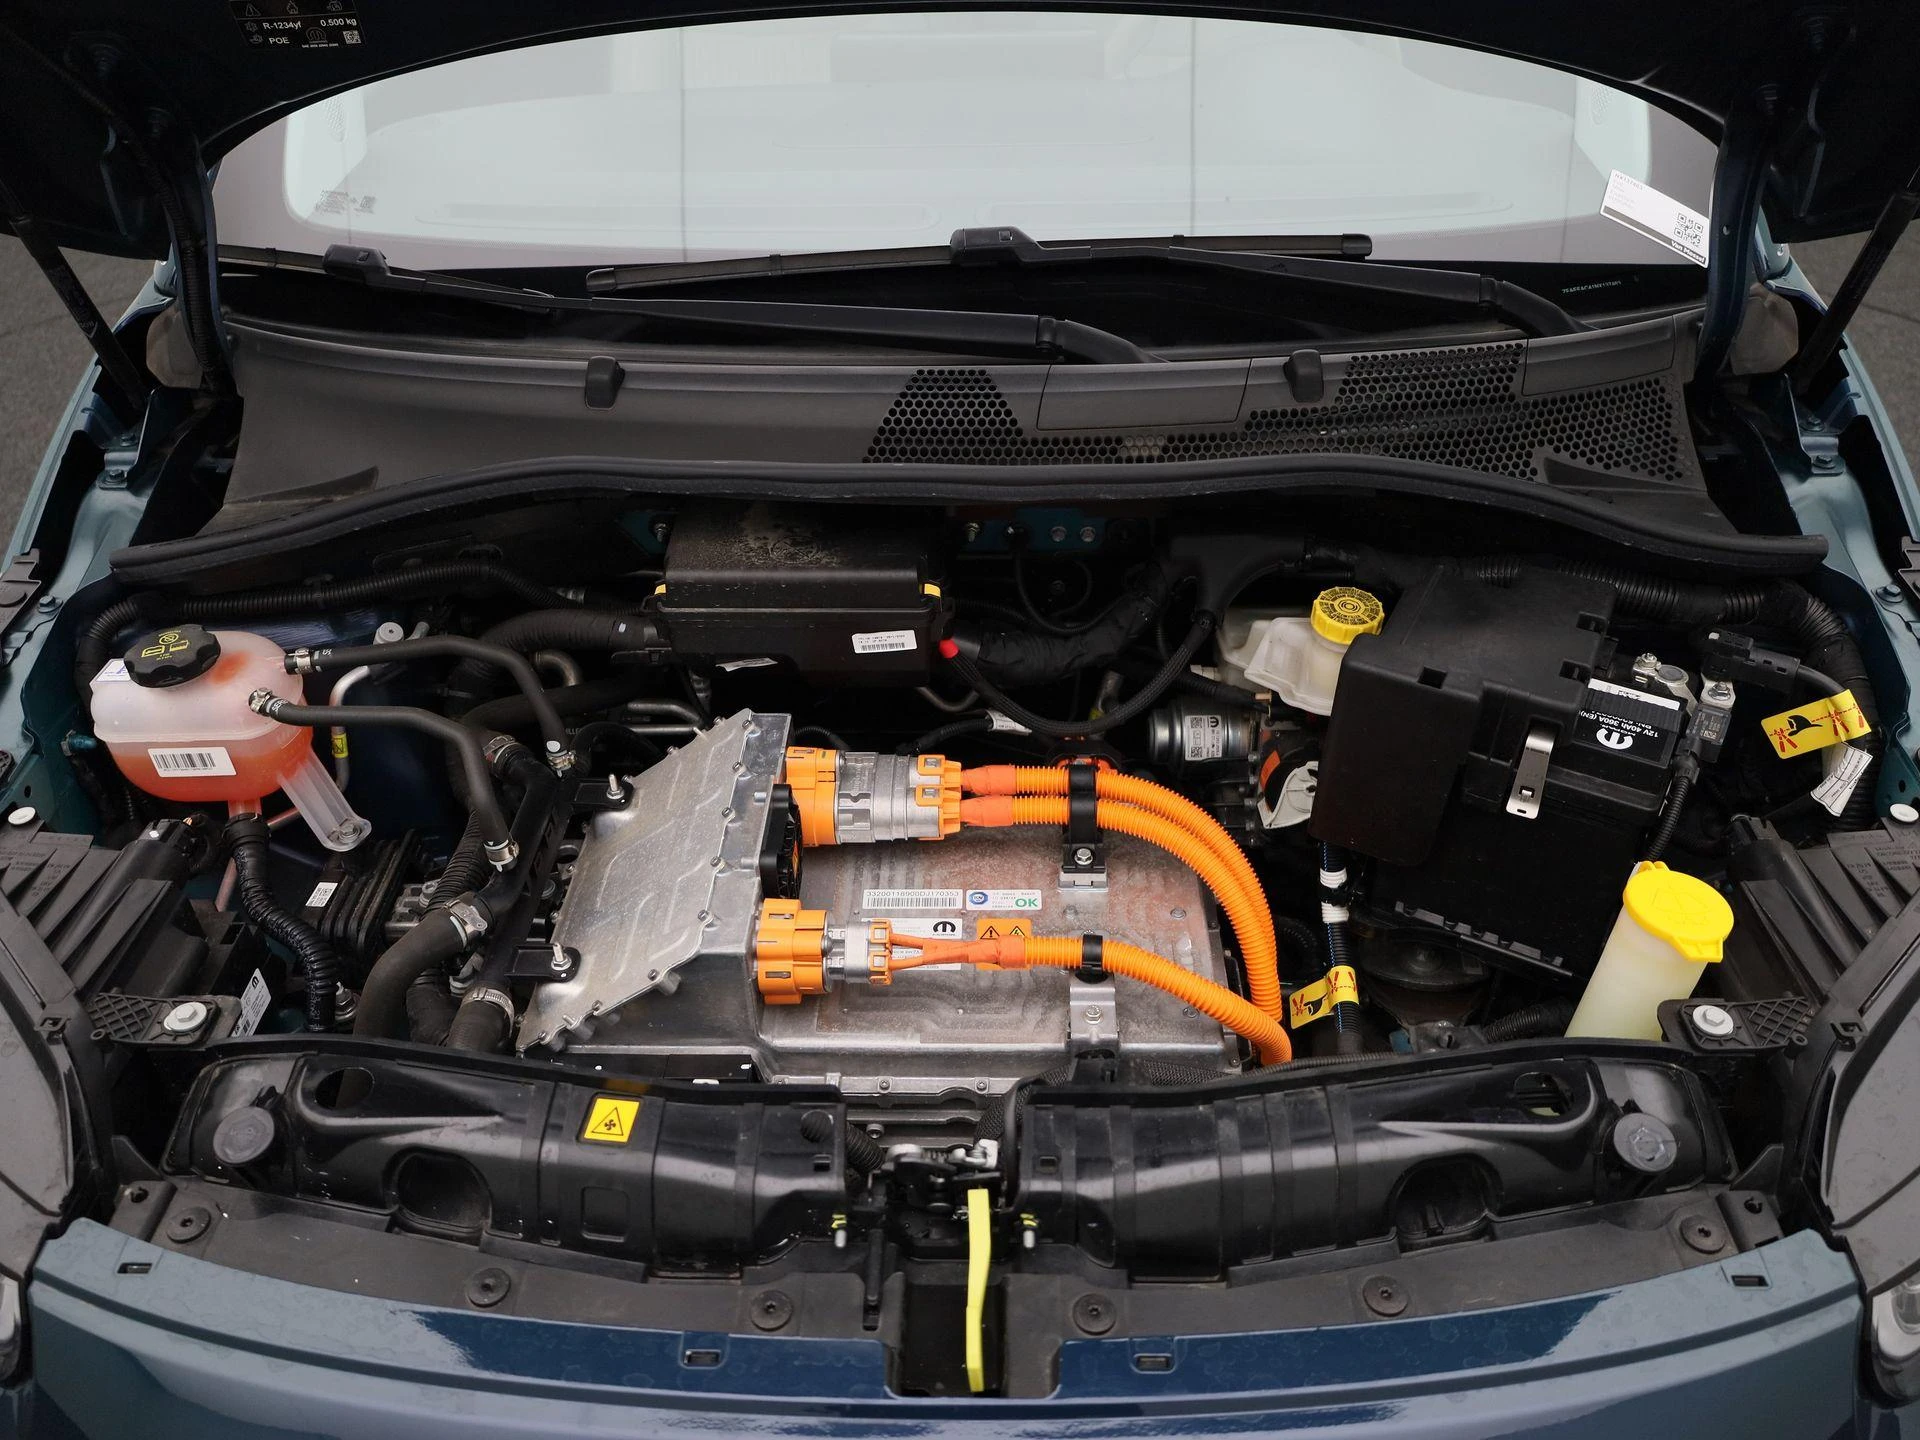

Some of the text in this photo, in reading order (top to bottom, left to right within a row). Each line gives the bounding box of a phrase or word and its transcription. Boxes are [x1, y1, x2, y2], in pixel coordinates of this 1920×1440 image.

[320, 18, 345, 27] 0.500
[346, 18, 357, 26] kg
[1599, 715, 1620, 726] 360A
[1621, 722, 1642, 732] 40Ah
[1643, 729, 1659, 738] 12V
[1015, 898, 1038, 907] OK
